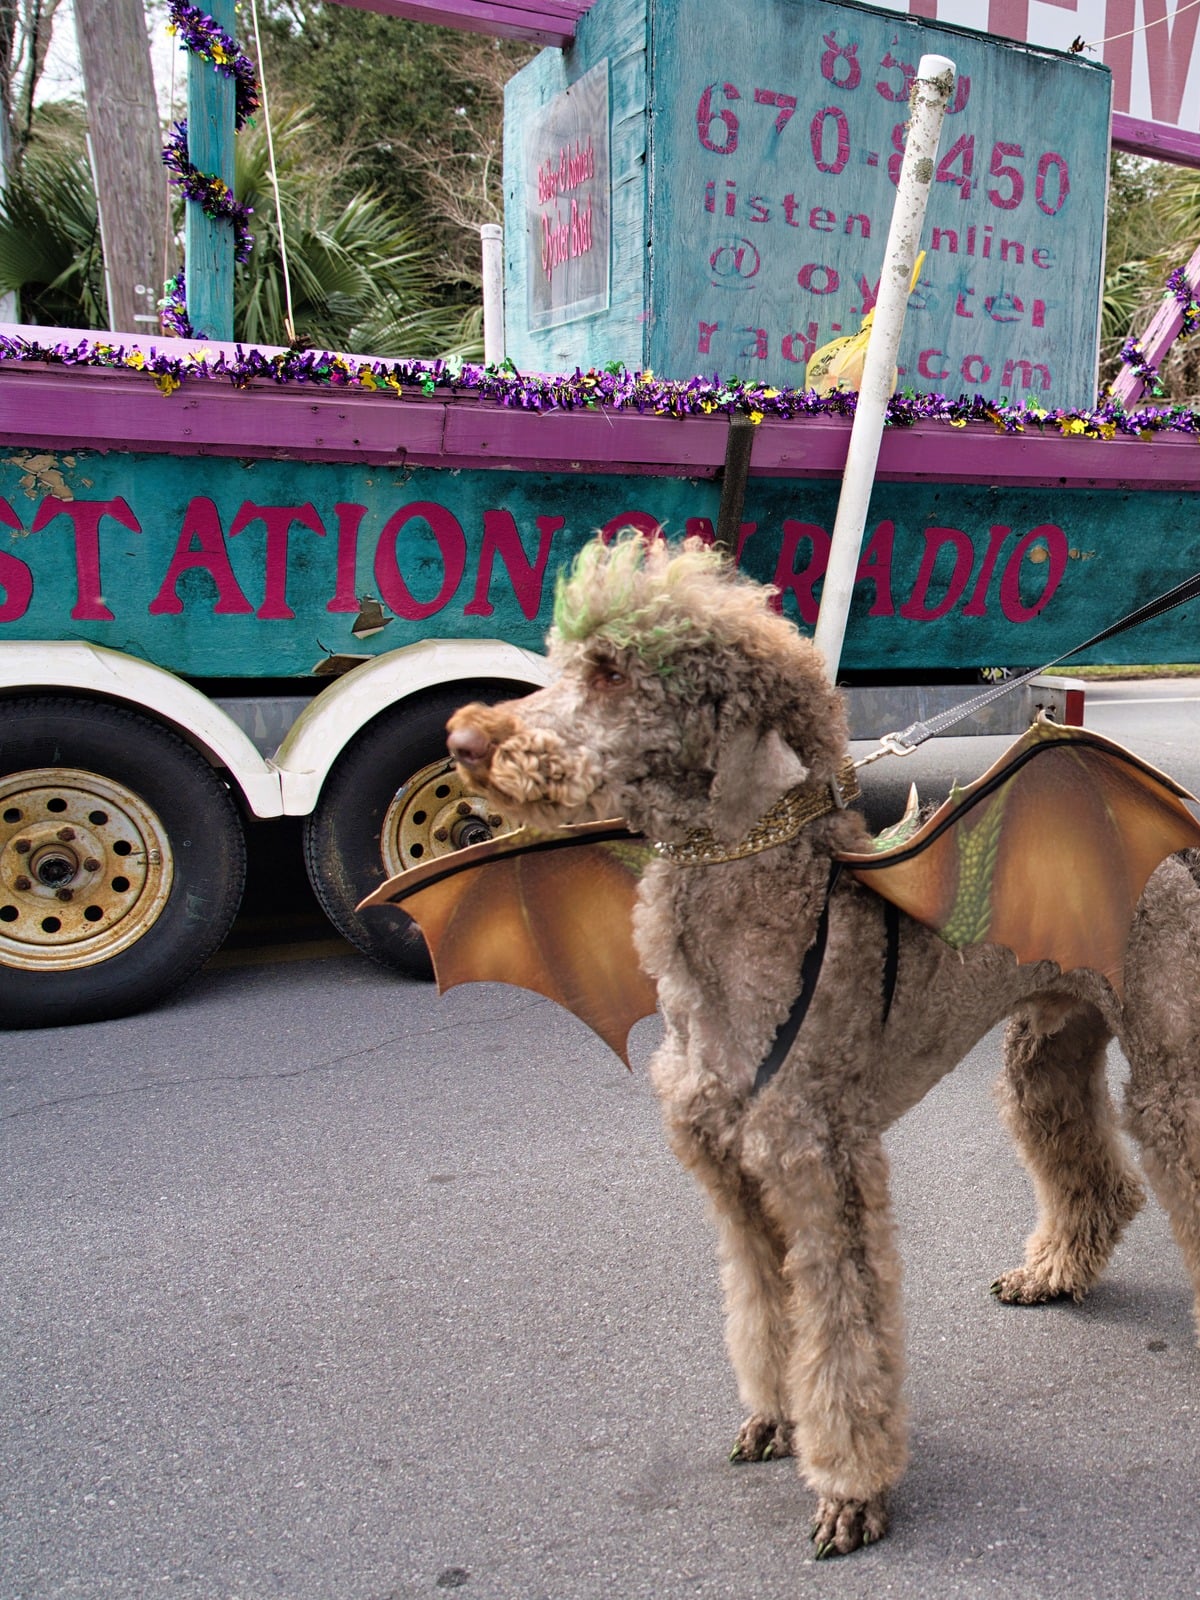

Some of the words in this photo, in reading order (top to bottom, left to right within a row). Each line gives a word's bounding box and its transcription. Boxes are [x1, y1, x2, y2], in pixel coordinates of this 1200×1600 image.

[541, 210, 569, 282] Oyster
[571, 193, 593, 257] Boat
[704, 181, 871, 238] listen
[931, 225, 1054, 269] nline
[709, 236, 761, 290] @
[772, 519, 1069, 624] RADIO
